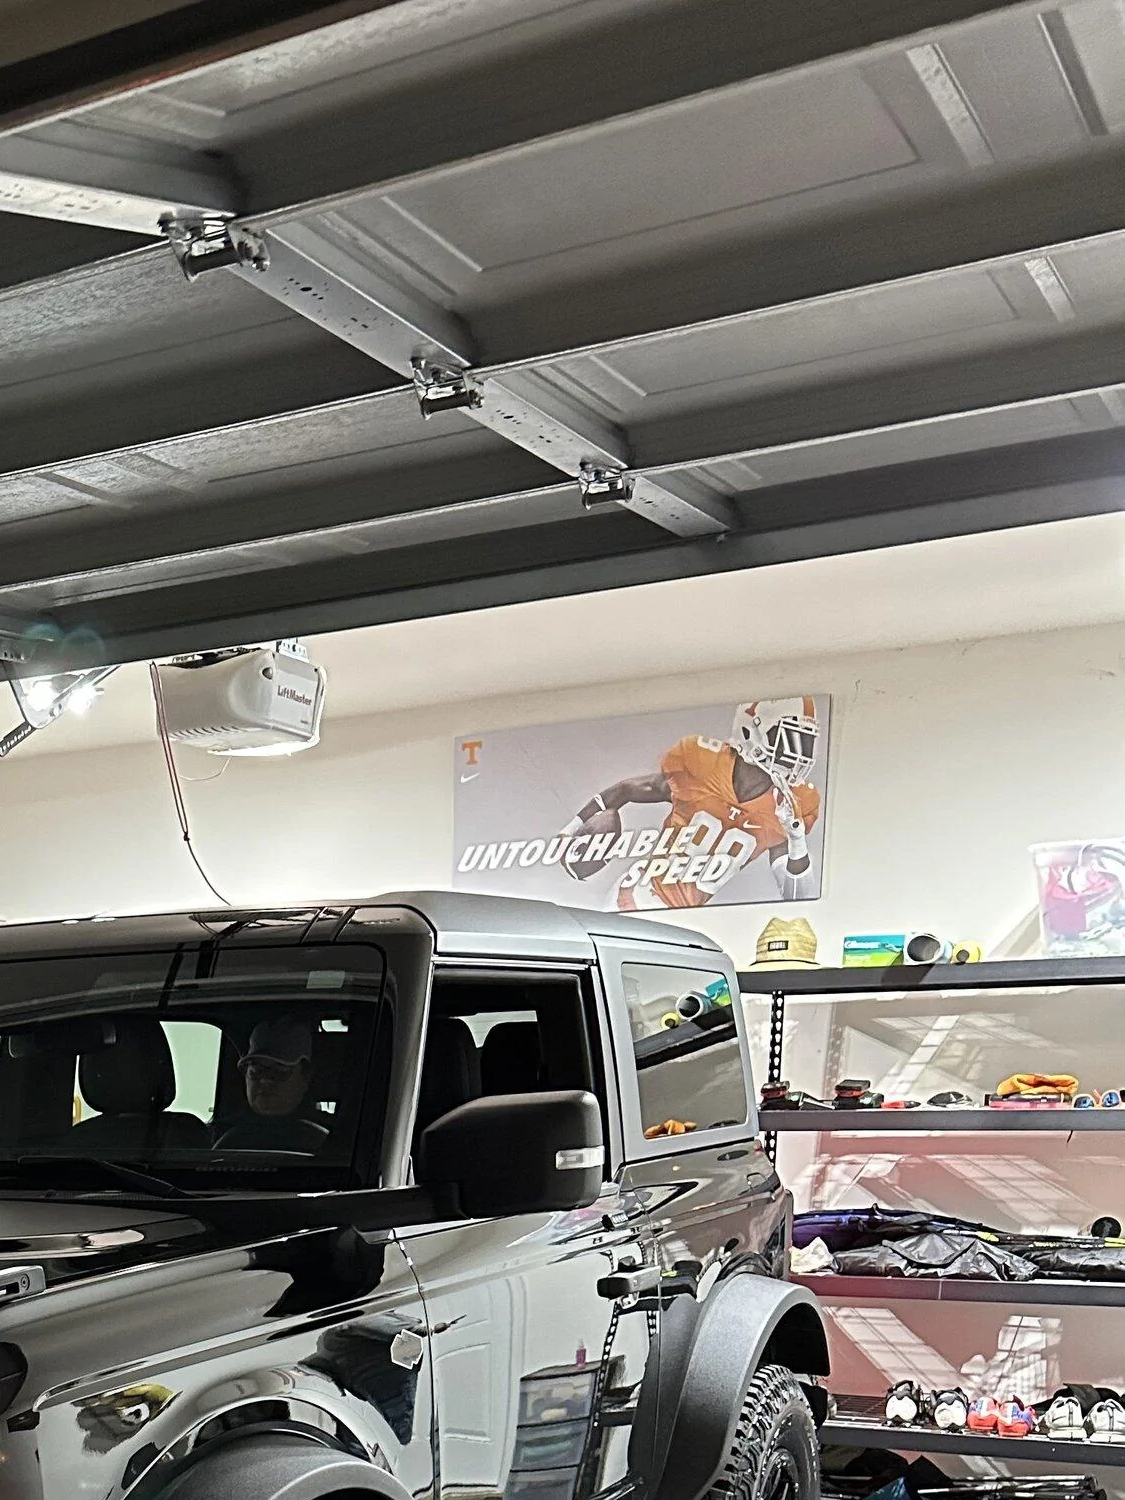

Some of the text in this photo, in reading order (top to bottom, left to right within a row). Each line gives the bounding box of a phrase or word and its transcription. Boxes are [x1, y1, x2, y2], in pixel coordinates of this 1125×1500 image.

[277, 685, 312, 706] LiftMaster
[457, 825, 695, 873] UNTOUCHABLE
[620, 853, 730, 888] SPEED
